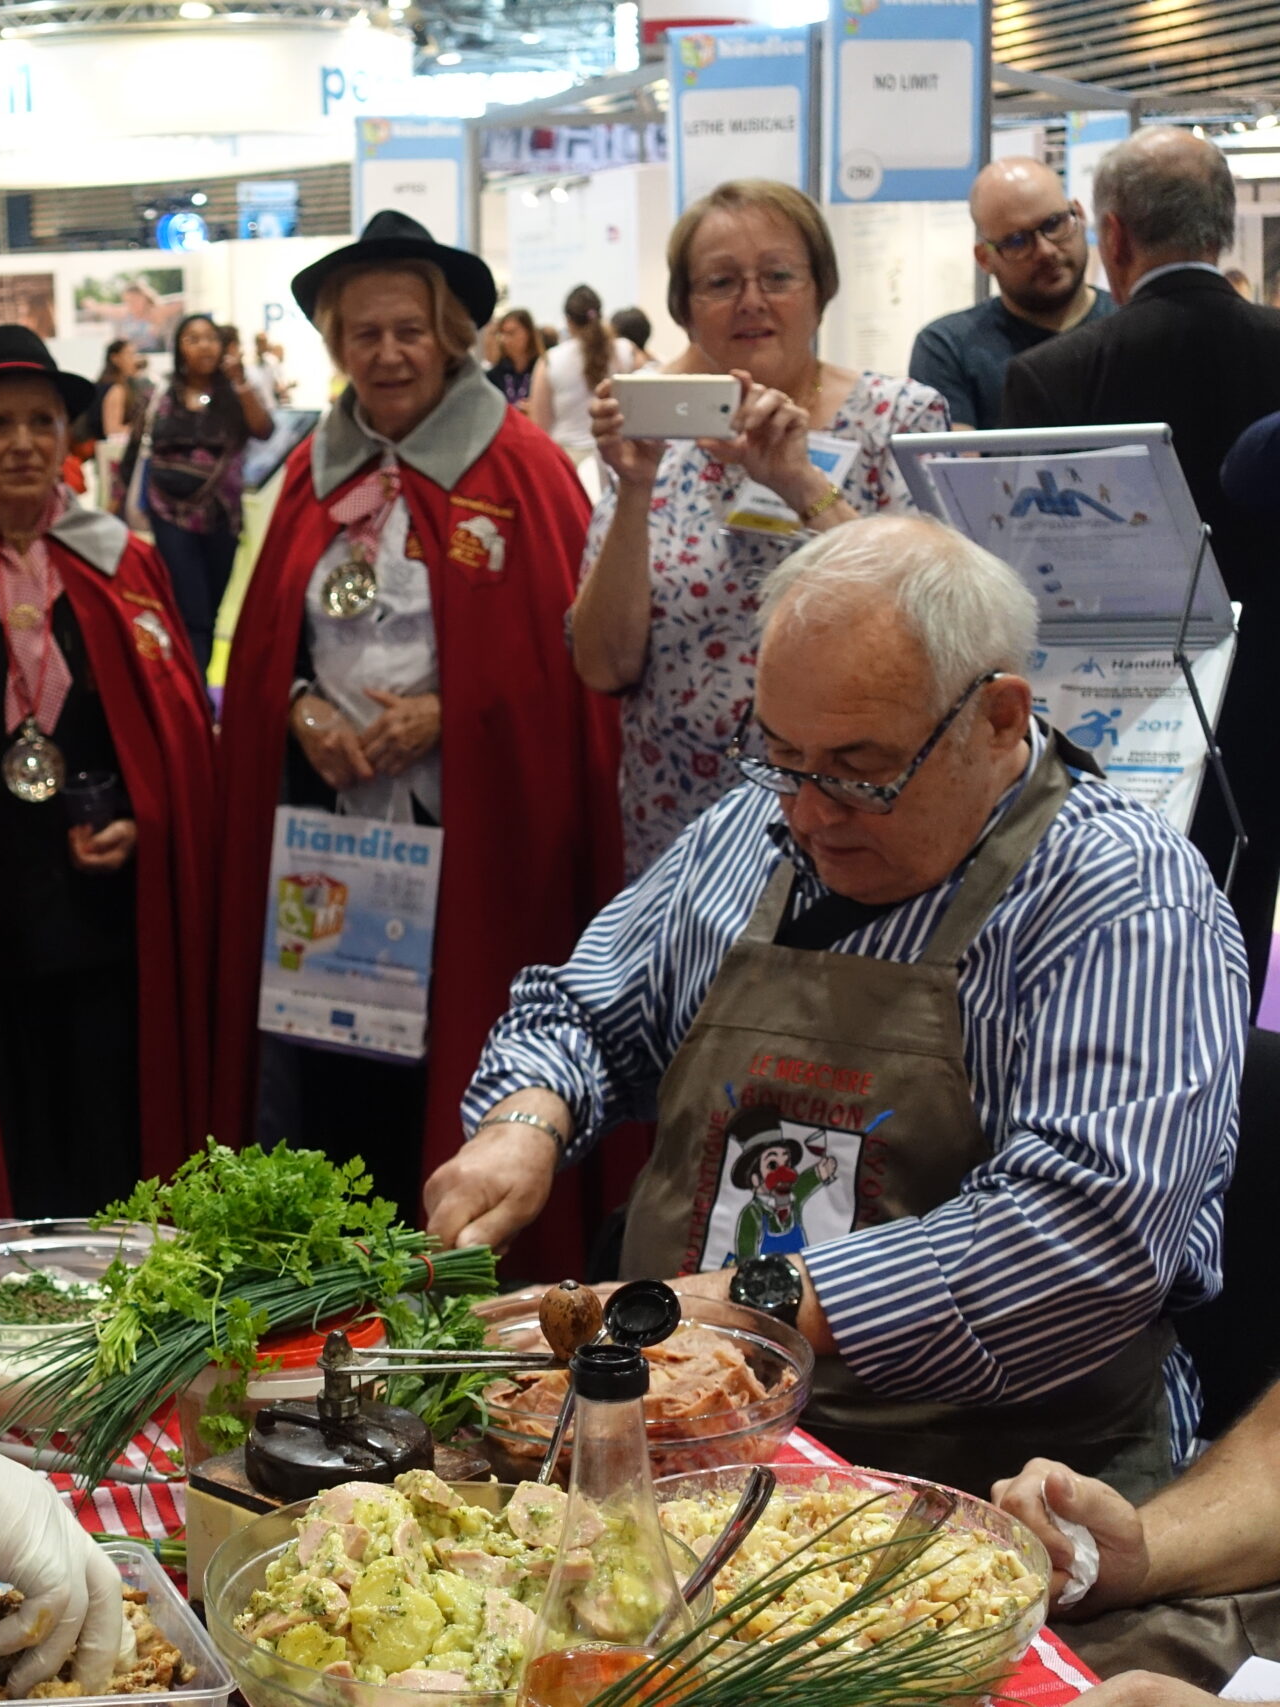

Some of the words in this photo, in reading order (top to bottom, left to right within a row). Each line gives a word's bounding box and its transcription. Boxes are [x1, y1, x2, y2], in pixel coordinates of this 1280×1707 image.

[873, 74, 896, 89] NO
[901, 73, 939, 90] LIMIT
[1136, 719, 1183, 732] 2017
[286, 817, 430, 865] handica
[750, 1055, 773, 1076] LE
[740, 1082, 865, 1129] BOUCHON
